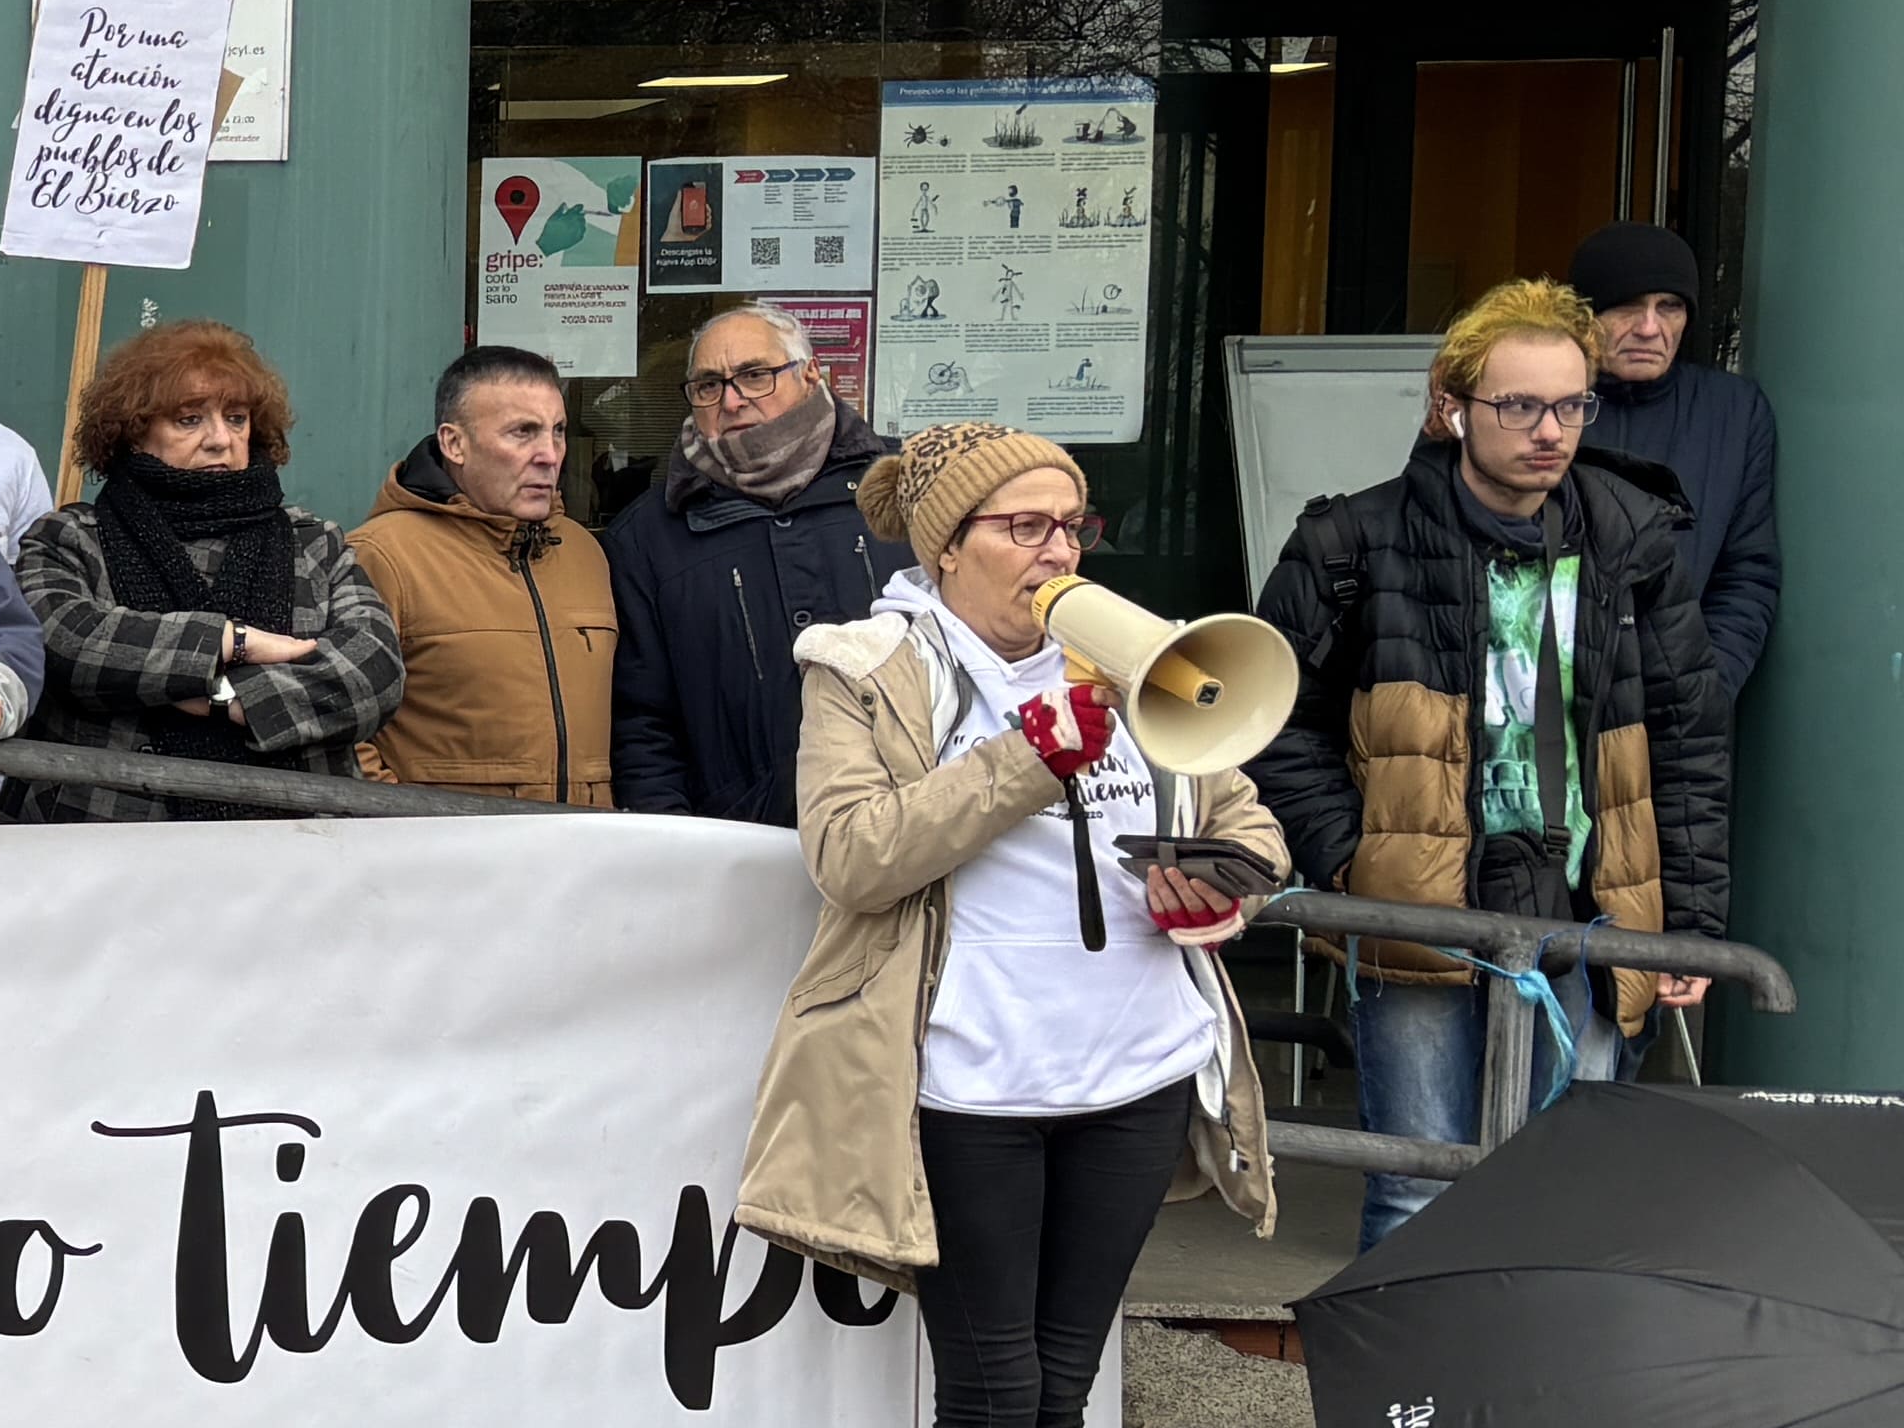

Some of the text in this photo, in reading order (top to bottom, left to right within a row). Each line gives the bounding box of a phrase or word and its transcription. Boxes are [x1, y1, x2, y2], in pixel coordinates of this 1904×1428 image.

[79, 6, 189, 49] Por una
[70, 48, 184, 90] atención
[33, 87, 202, 143] digna en los
[25, 135, 185, 181] pueblos de
[30, 168, 180, 217] El Bierzo
[485, 272, 519, 284] corta
[486, 249, 544, 273] gripe:
[485, 293, 518, 304] sano
